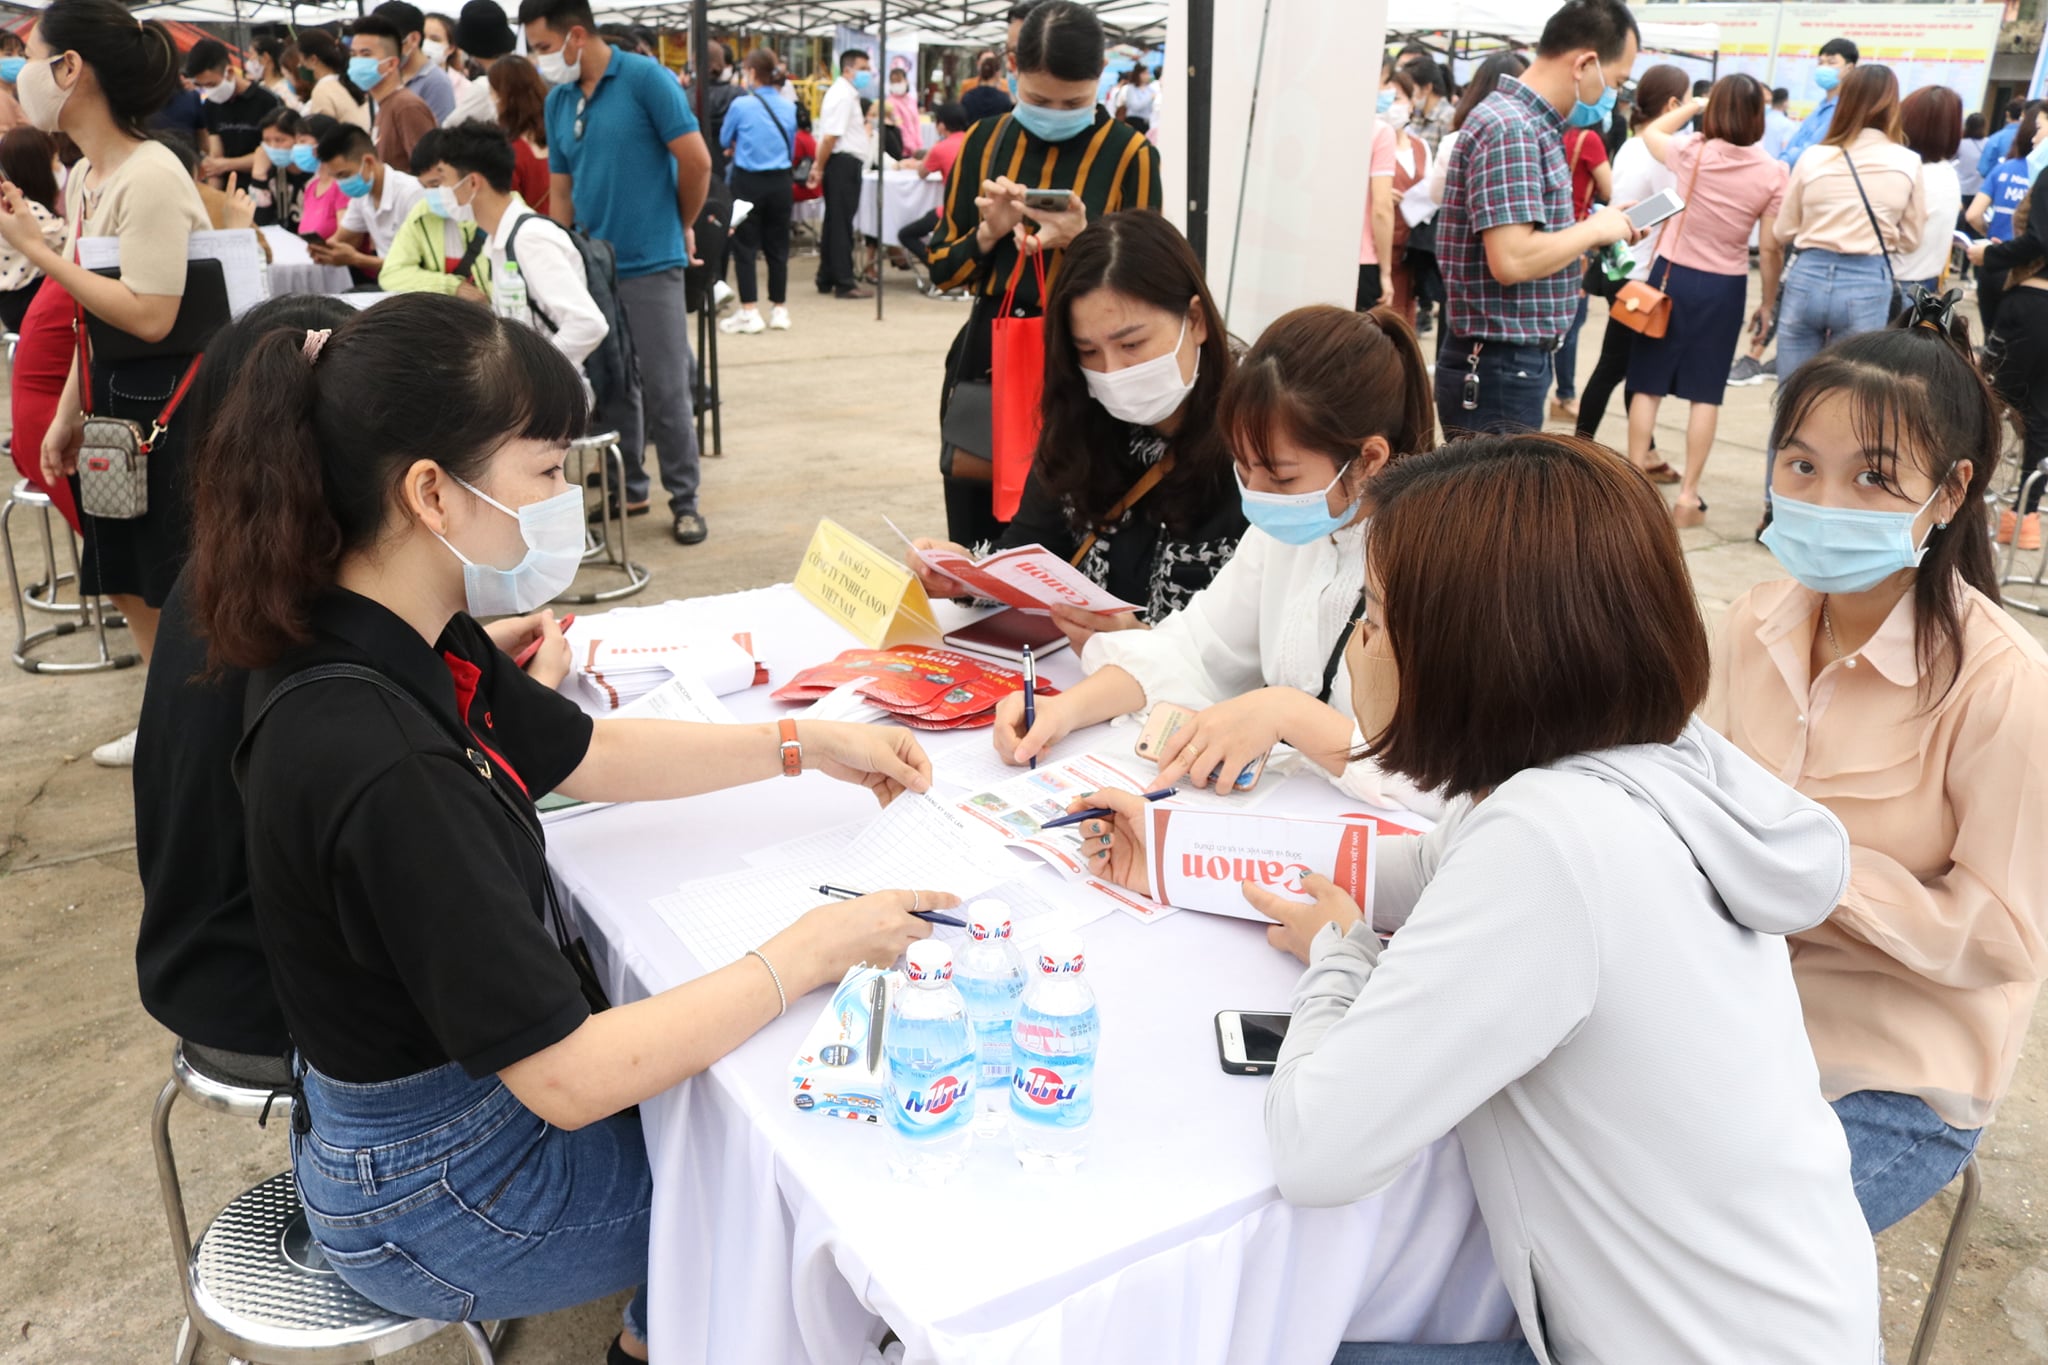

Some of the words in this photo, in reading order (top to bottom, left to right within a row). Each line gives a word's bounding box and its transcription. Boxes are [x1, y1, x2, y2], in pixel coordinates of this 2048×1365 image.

[808, 551, 828, 574] CÔNG
[828, 565, 841, 581] TY
[838, 571, 861, 599] TNHH
[858, 589, 888, 617] CANON
[1015, 561, 1089, 607] Canon
[839, 596, 857, 619] NAM
[1182, 853, 1313, 894] Canon
[1350, 863, 1358, 886] CANON
